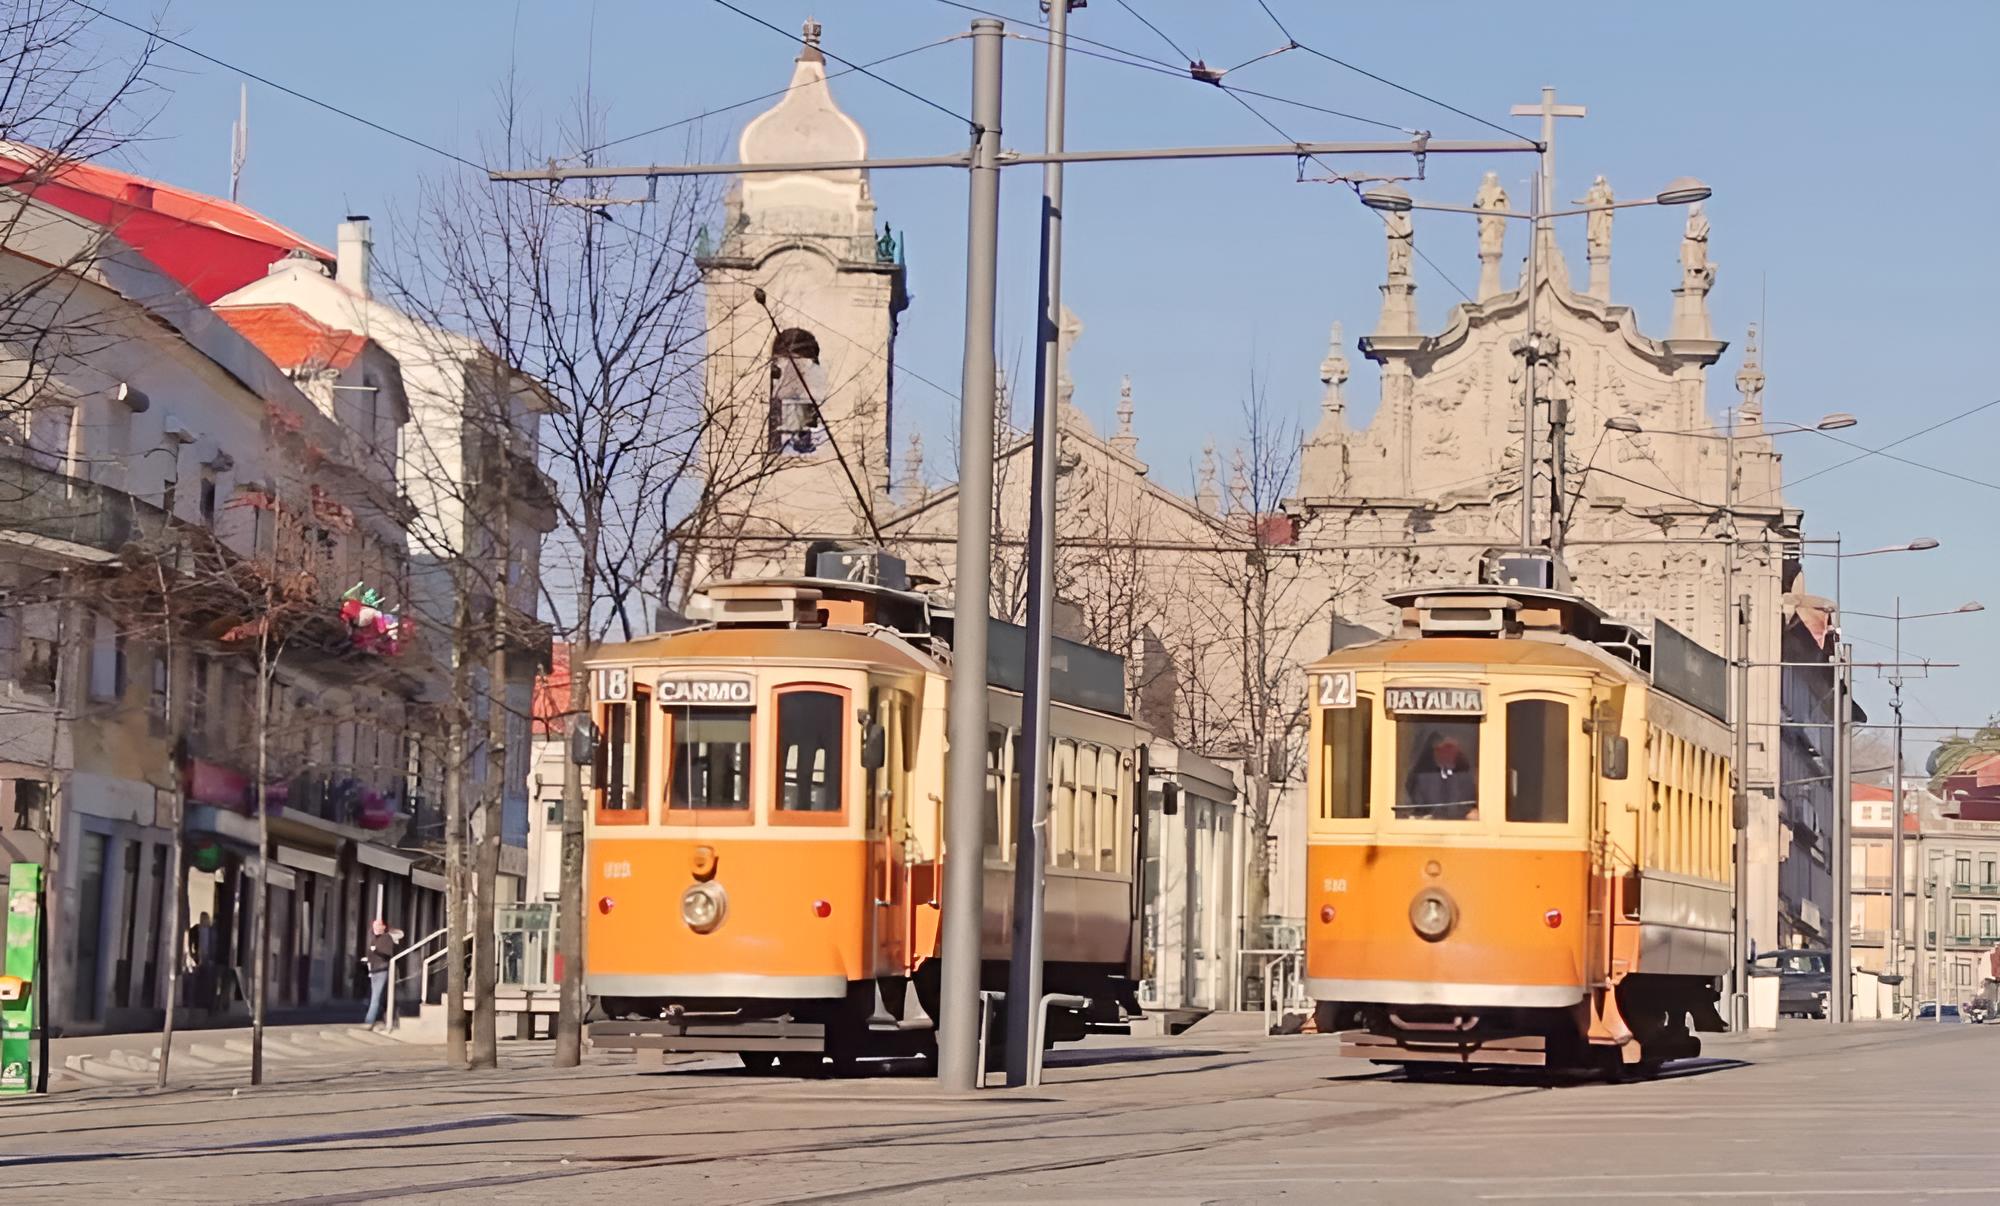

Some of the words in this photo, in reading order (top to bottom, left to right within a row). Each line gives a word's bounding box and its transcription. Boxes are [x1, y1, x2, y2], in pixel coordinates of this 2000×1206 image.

[599, 669, 626, 700] 18
[658, 682, 749, 700] CARMO
[1319, 674, 1350, 704] 22
